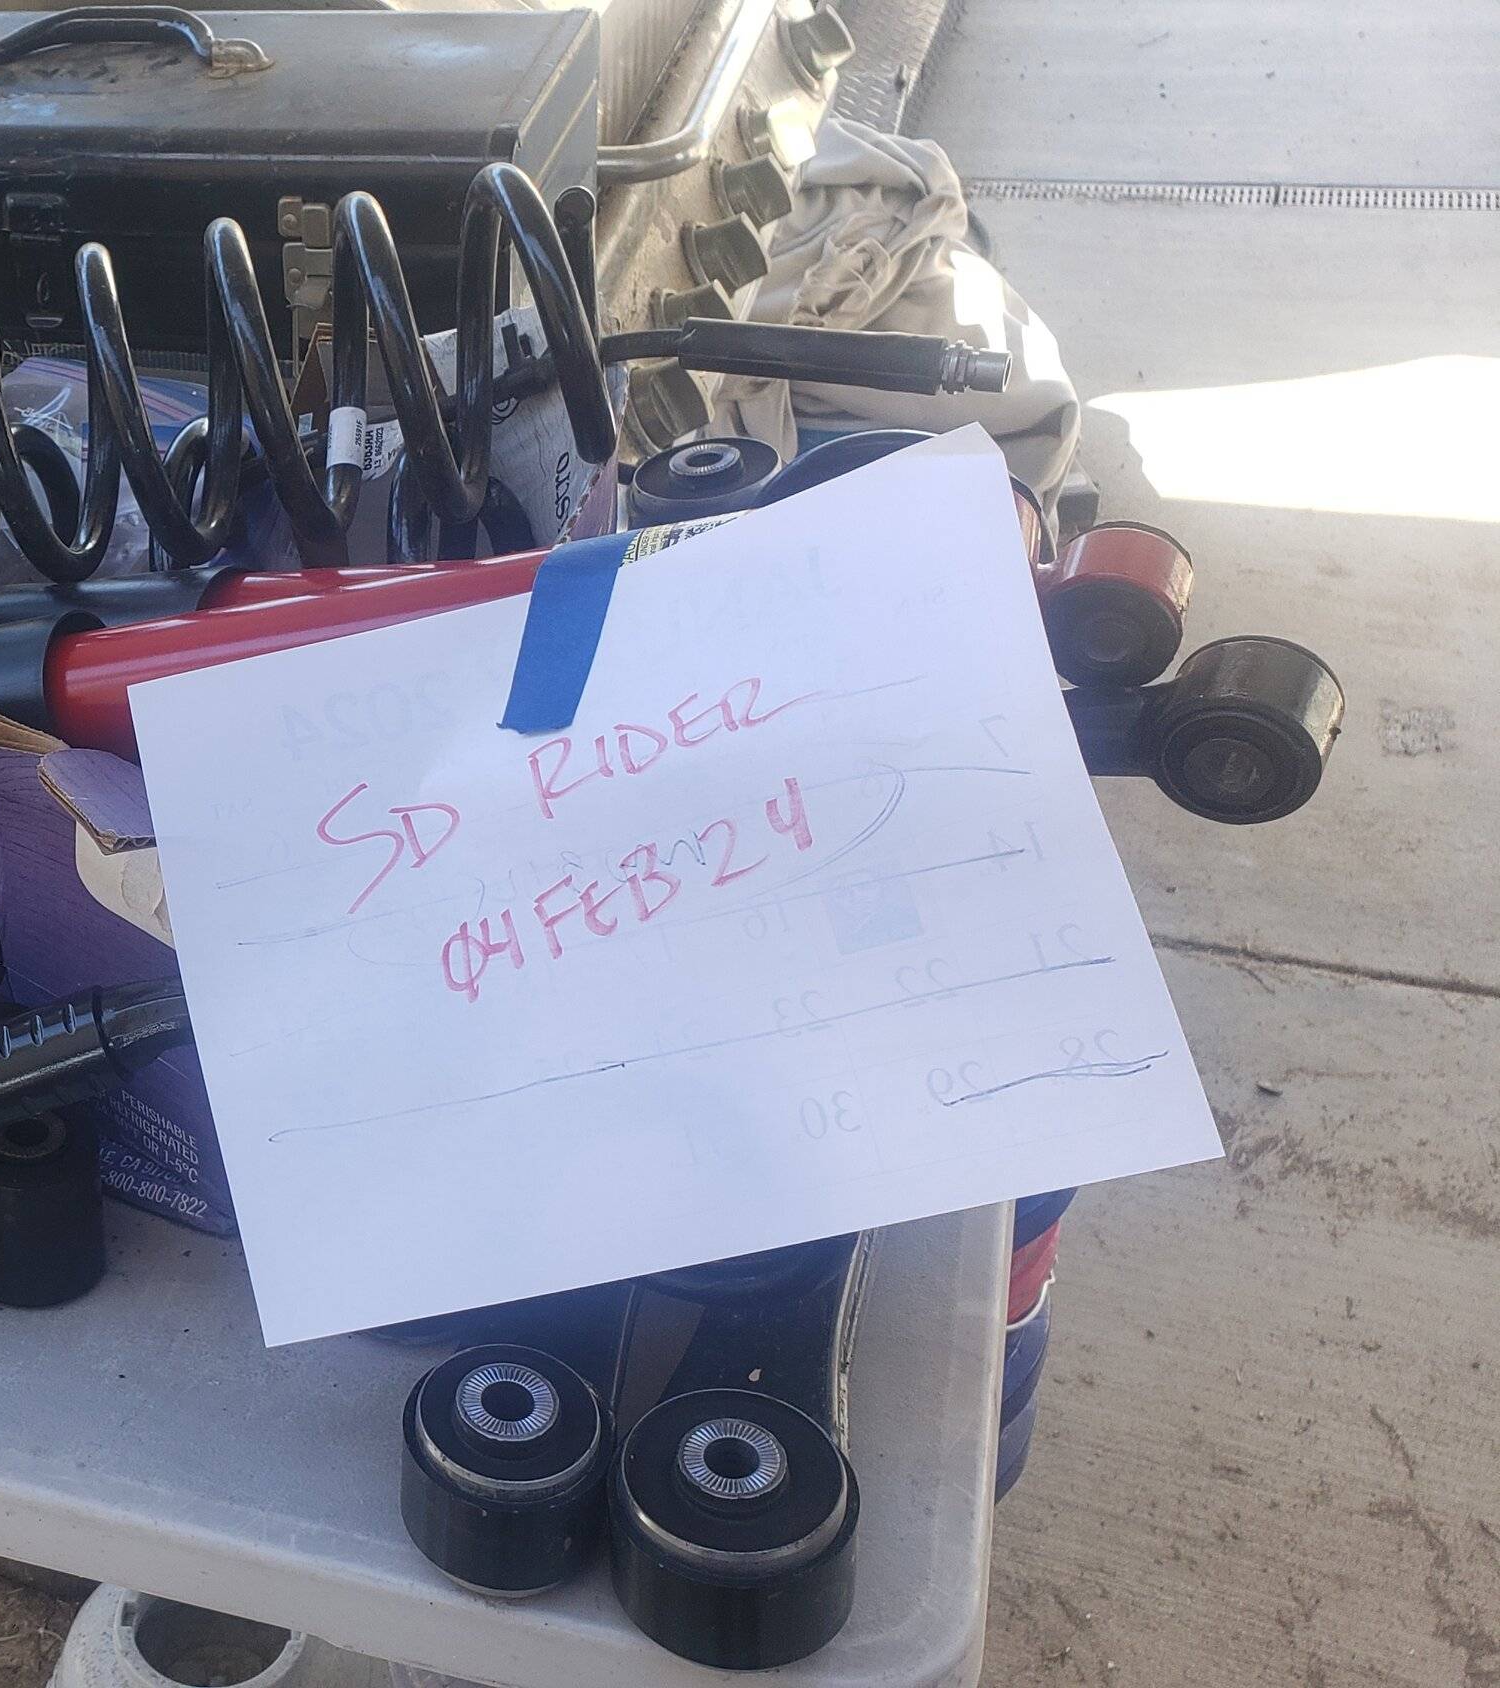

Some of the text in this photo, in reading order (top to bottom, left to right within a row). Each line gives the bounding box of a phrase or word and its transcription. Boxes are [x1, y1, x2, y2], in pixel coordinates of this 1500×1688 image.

[555, 451, 571, 533] istro
[316, 782, 461, 915] SD
[527, 677, 825, 819] RIDER
[110, 1096, 199, 1165] REFRIGERATED
[121, 1090, 198, 1151] PERISHABLE
[143, 1136, 159, 1155] OR
[100, 1170, 208, 1218] -800-800-7822
